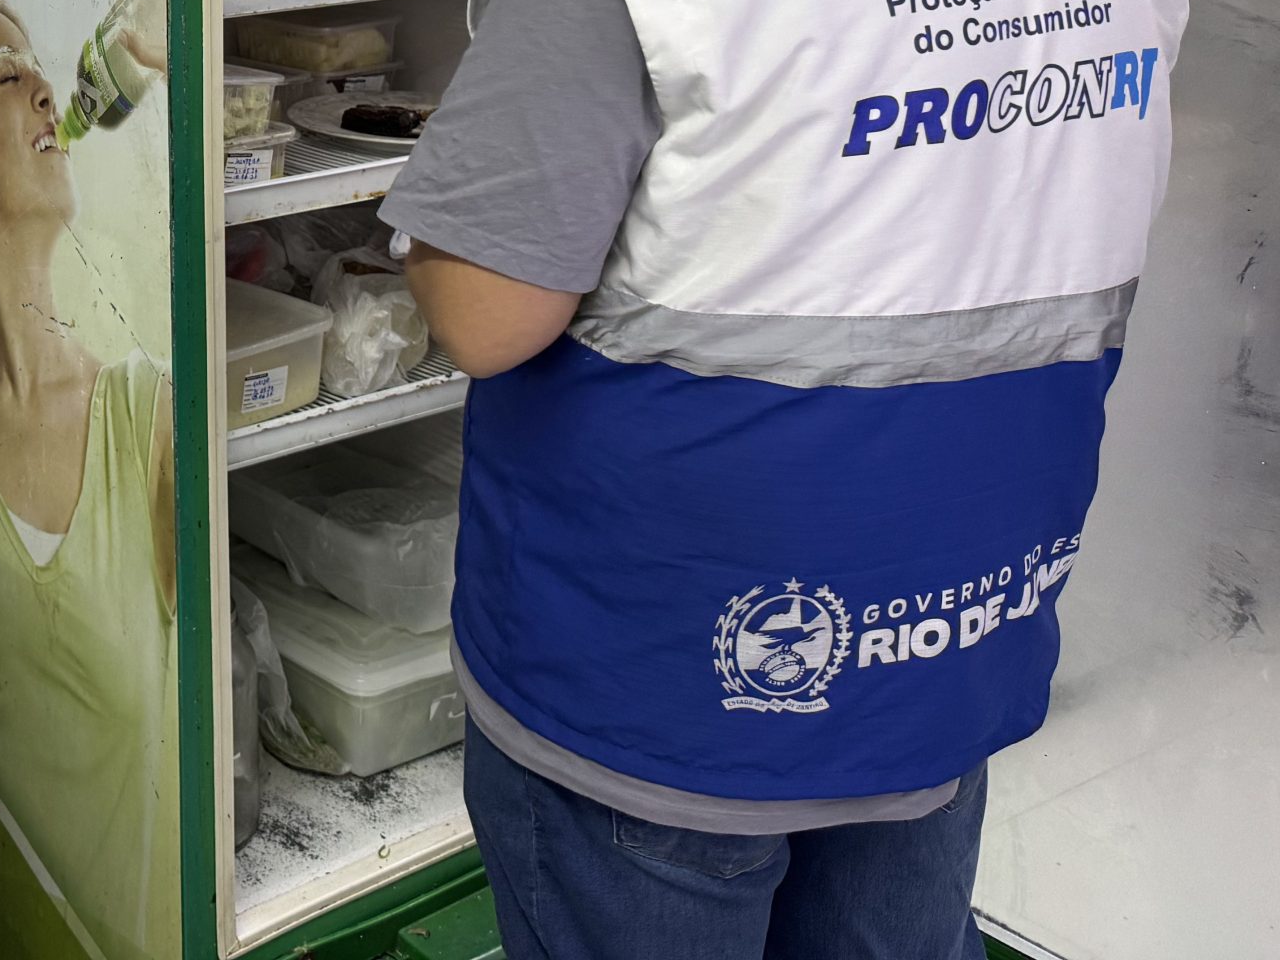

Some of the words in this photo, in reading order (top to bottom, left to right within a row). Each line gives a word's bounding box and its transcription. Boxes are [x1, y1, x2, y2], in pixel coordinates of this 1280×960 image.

[913, 25, 954, 54] do
[962, 0, 1112, 46] Consumidor
[842, 47, 1159, 157] PROCONRJ
[863, 566, 1011, 624] GOVERNO
[1024, 544, 1041, 576] DO
[857, 618, 951, 668] RIO
[959, 593, 1006, 650] DE
